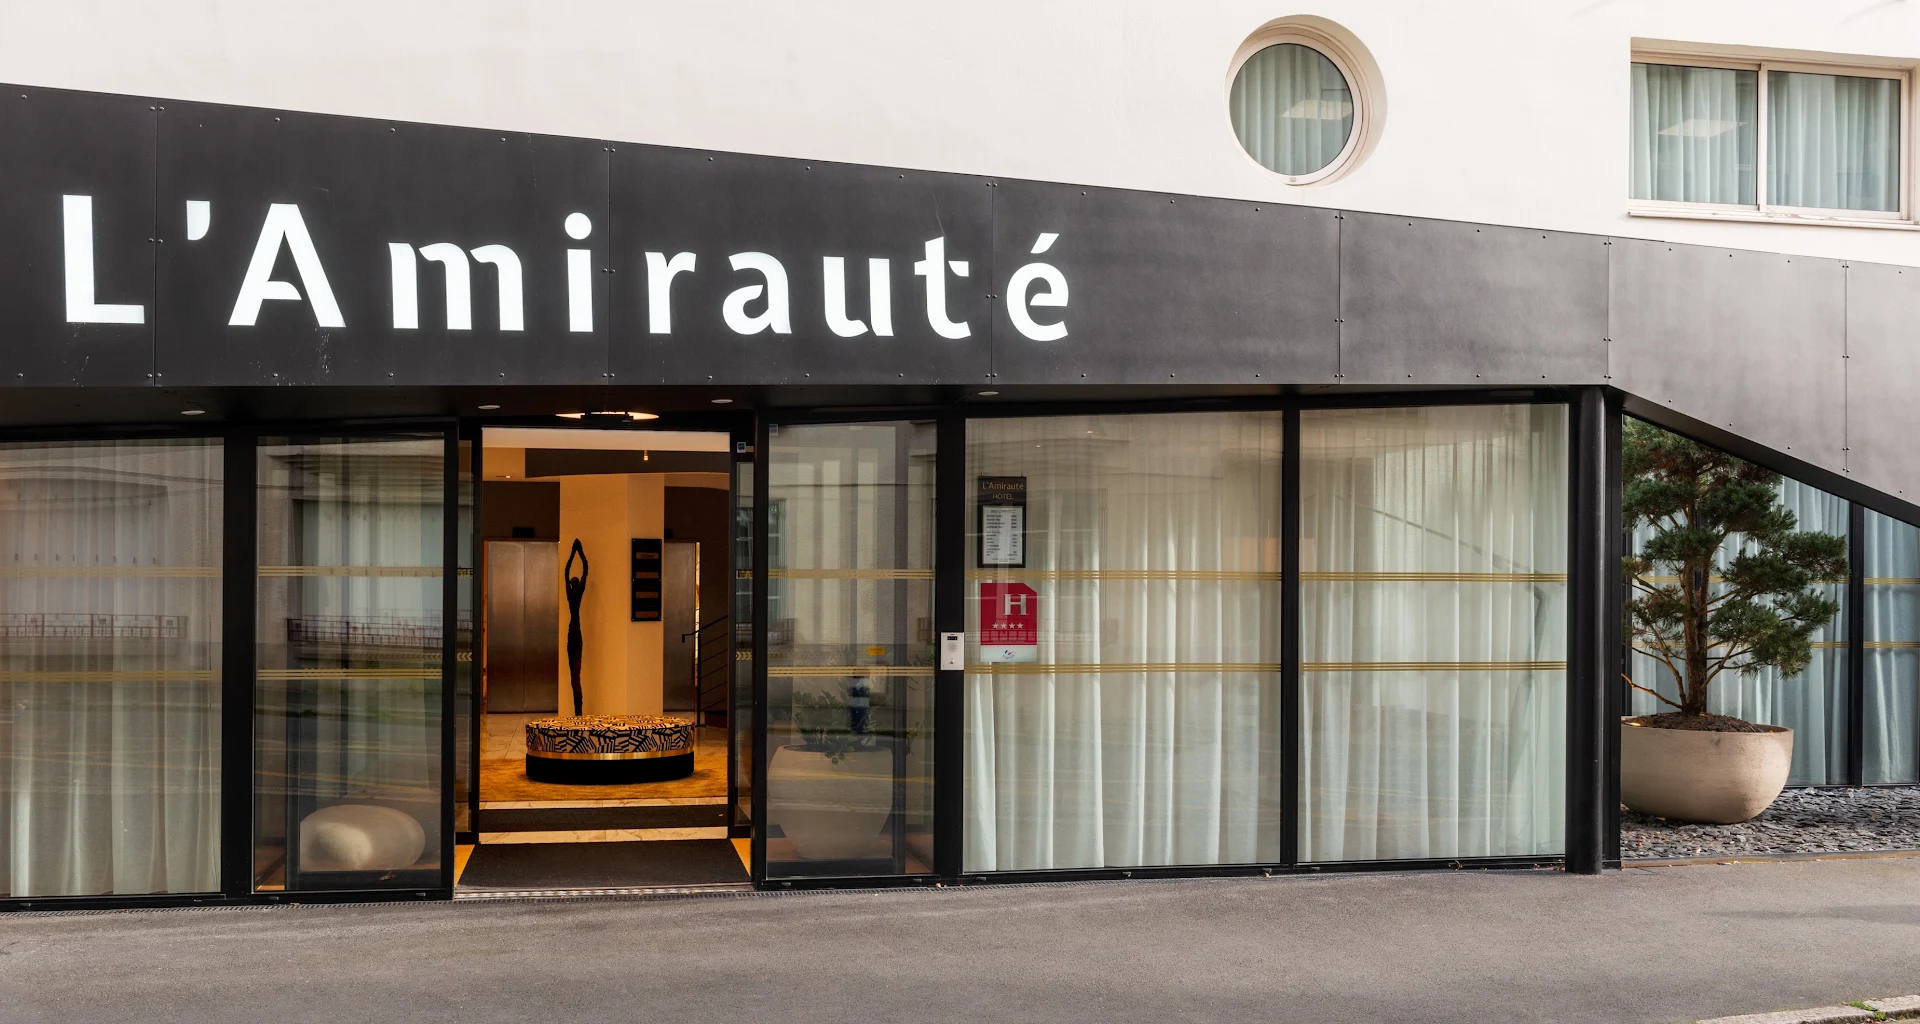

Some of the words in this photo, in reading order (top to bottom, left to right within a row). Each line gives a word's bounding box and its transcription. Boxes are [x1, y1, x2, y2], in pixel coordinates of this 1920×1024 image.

[63, 194, 1070, 342] L'Amirauté
[982, 481, 1024, 490] L'Amirauté
[992, 492, 1014, 500] HÔTEL
[1002, 593, 1030, 616] H
